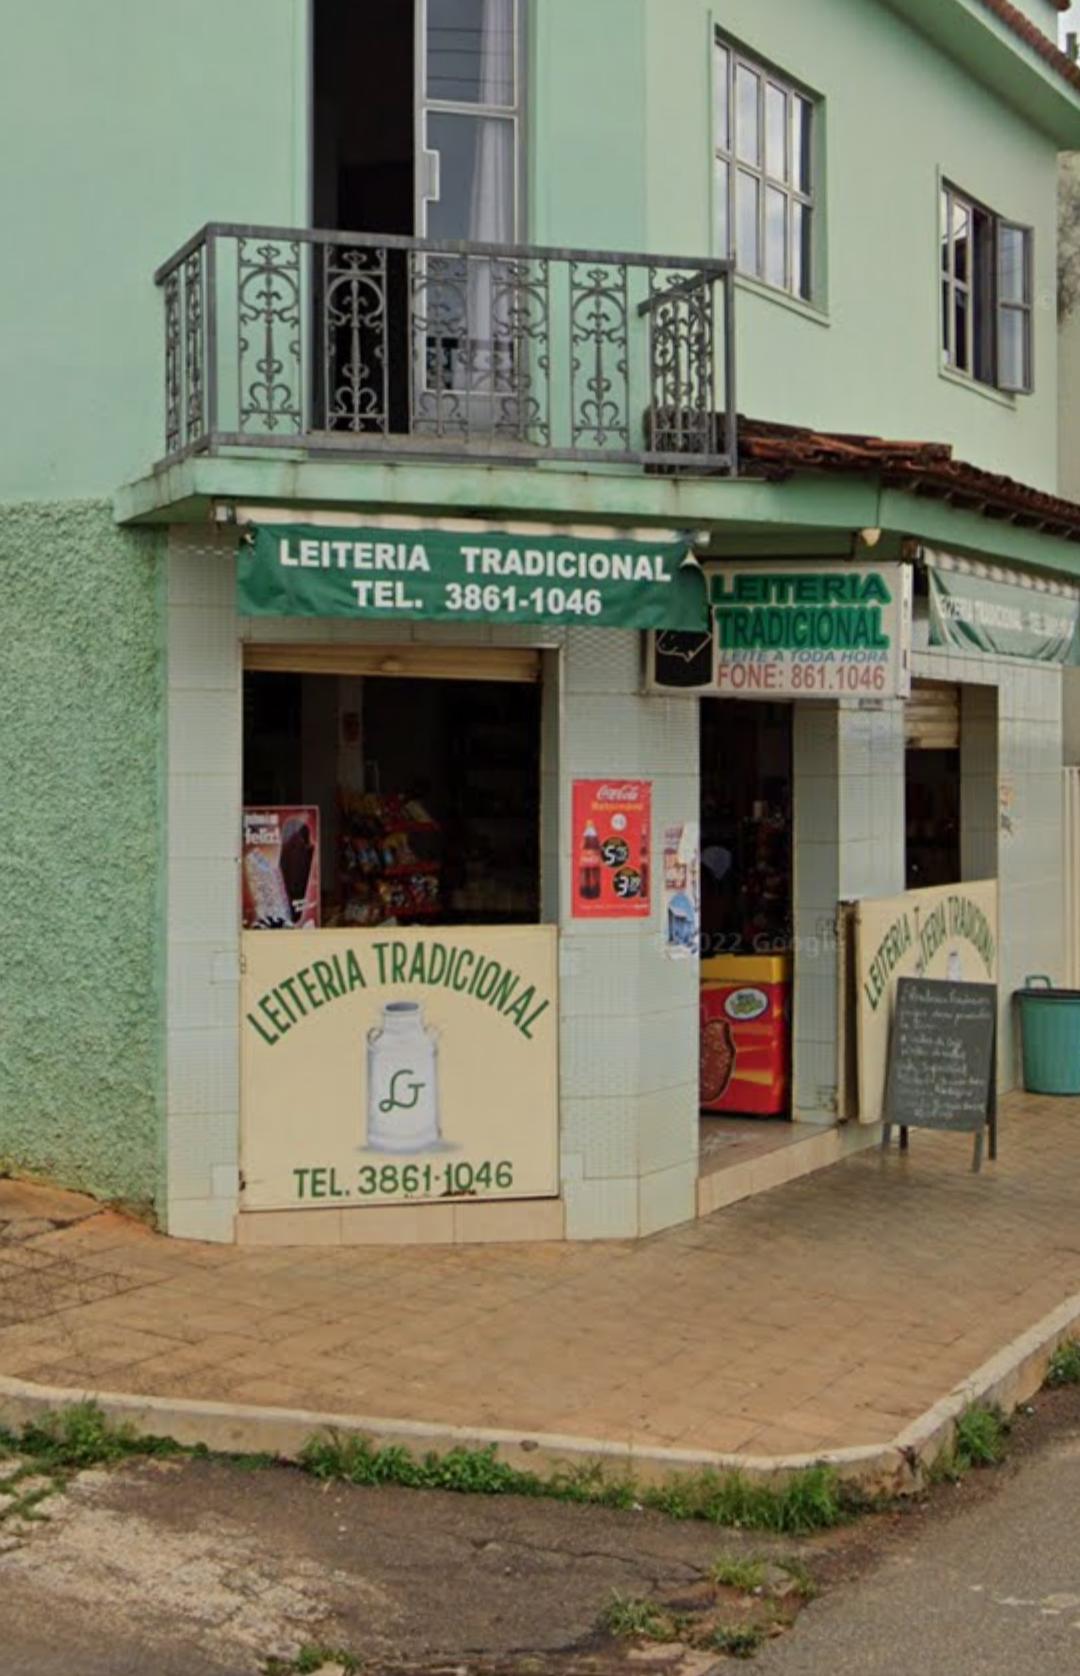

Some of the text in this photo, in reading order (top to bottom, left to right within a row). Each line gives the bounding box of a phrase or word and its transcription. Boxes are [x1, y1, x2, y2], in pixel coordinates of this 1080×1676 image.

[279, 538, 672, 582] LEITERIA TRADICIONAL
[352, 580, 602, 616] TEL. 3861-1046
[710, 573, 892, 605] LEITERIA
[716, 607, 890, 650] TRADICIONAL
[716, 664, 886, 690] FONE: 861.1046
[246, 941, 550, 1046] LEITERIA TRADICIONAL
[293, 1167, 350, 1198] TEL.
